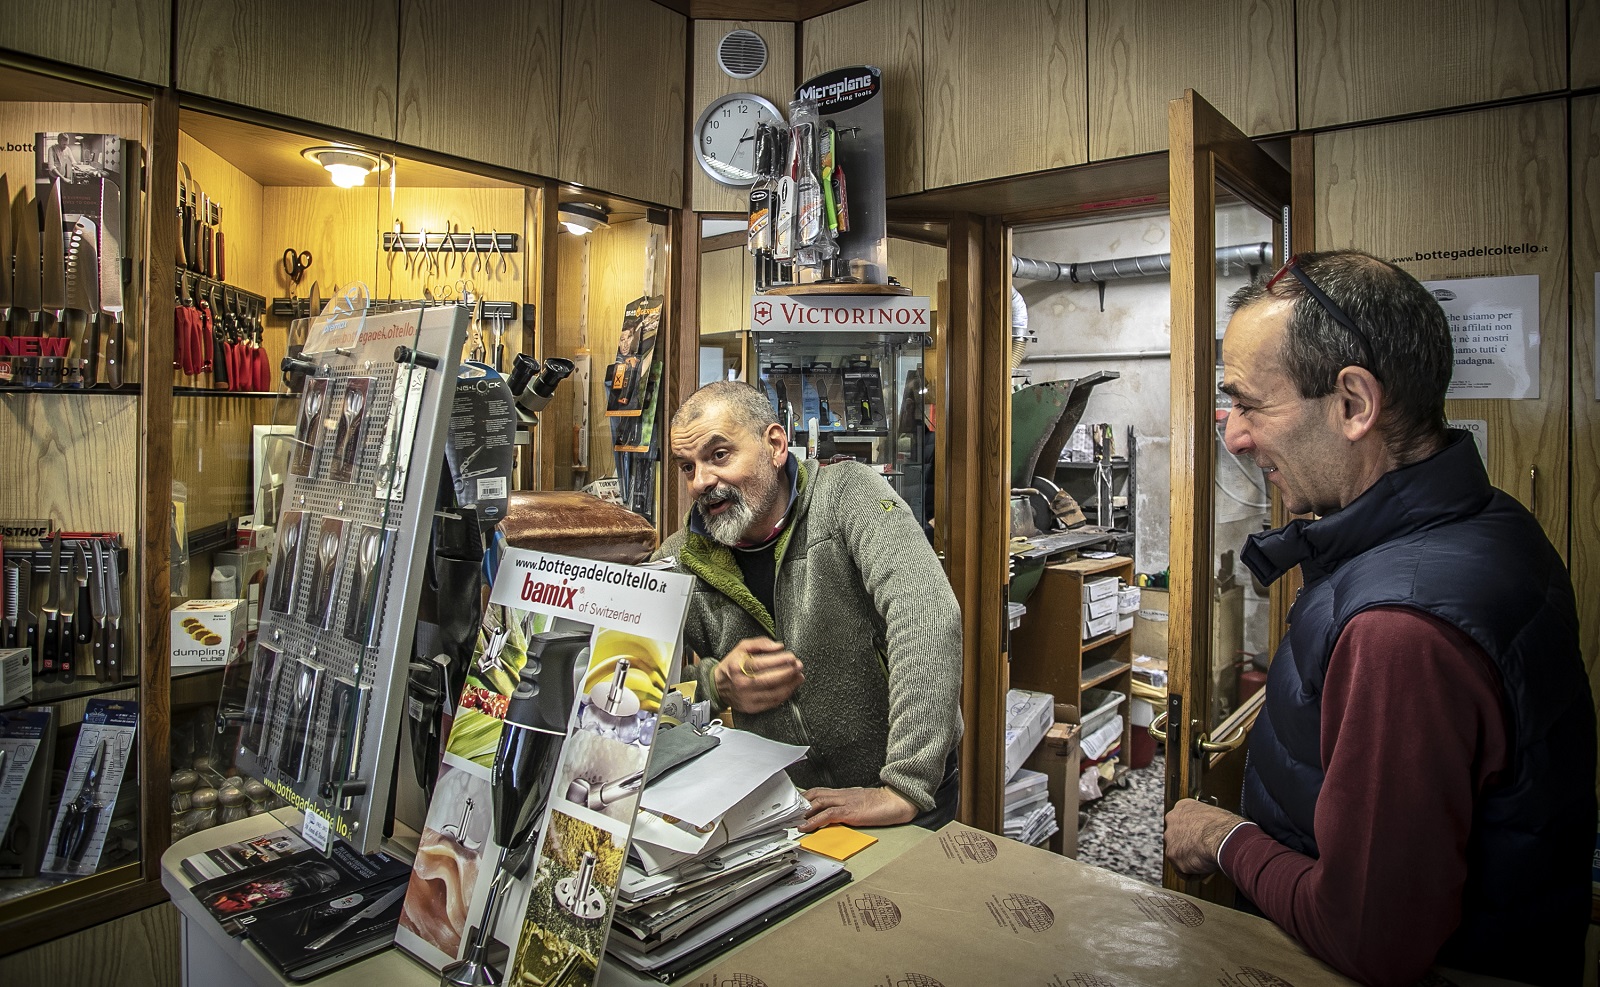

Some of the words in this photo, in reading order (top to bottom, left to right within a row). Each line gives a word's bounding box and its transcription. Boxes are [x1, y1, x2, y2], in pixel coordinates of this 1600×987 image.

[800, 75, 871, 102] Microplane
[854, 90, 872, 98] Tools
[723, 110, 731, 118] 11
[738, 105, 748, 114] 12
[757, 110, 761, 118] 1
[709, 120, 720, 129] 10
[706, 136, 712, 144] 9
[1391, 243, 1548, 263] www.bottegadelcoltello.it
[780, 303, 926, 324] VICTORINOX
[1498, 312, 1512, 321] per
[1462, 323, 1492, 331] affilati
[1484, 334, 1508, 342] nostri
[0, 336, 70, 356] NEW
[1480, 344, 1498, 353] tutti
[515, 556, 667, 593] www.bottegadelcoltello.it
[520, 572, 578, 610] bamix
[578, 602, 589, 612] of
[590, 603, 642, 624] Switzerland
[172, 648, 226, 657] dumpling
